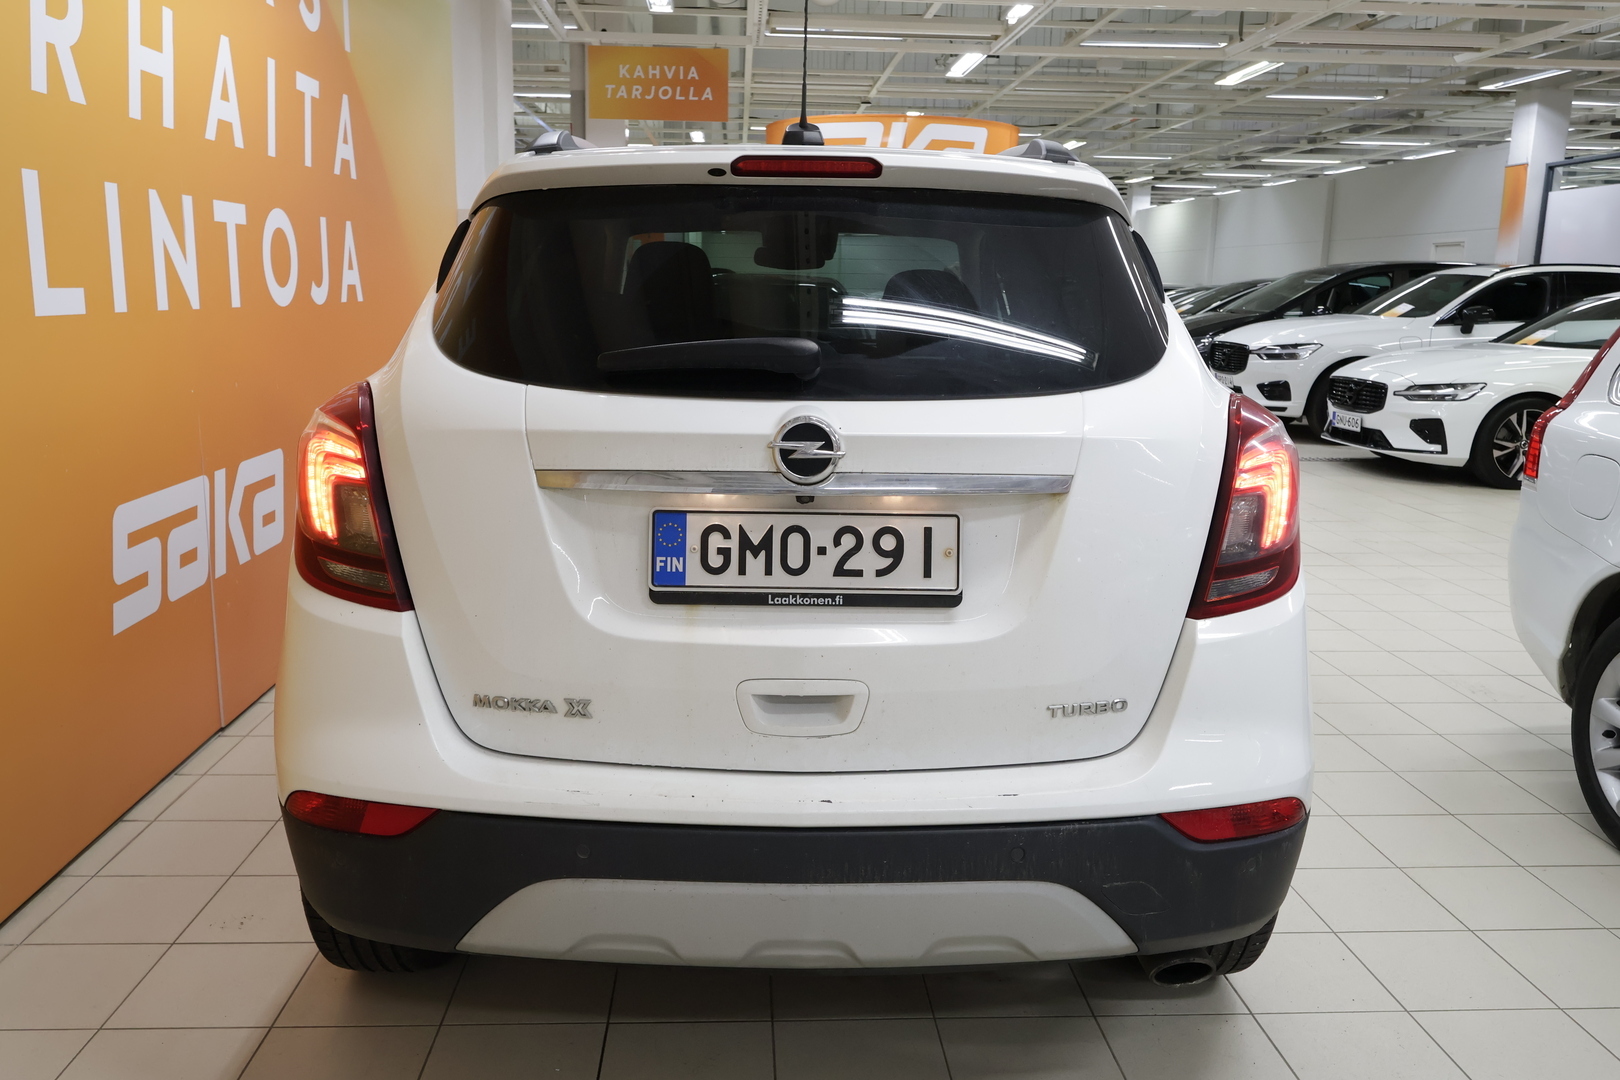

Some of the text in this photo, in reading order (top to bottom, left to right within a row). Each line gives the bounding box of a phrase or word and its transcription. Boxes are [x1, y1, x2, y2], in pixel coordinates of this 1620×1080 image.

[618, 64, 700, 80] KAHVIA
[605, 84, 714, 101] TARJOLLA
[21, 167, 364, 317] LINTOJA
[700, 523, 933, 579] GMO-291
[656, 556, 684, 573] FIN
[767, 594, 844, 606] Laakkonen.fi
[472, 693, 593, 720] MOKKA X
[1046, 698, 1128, 719] TURBO
